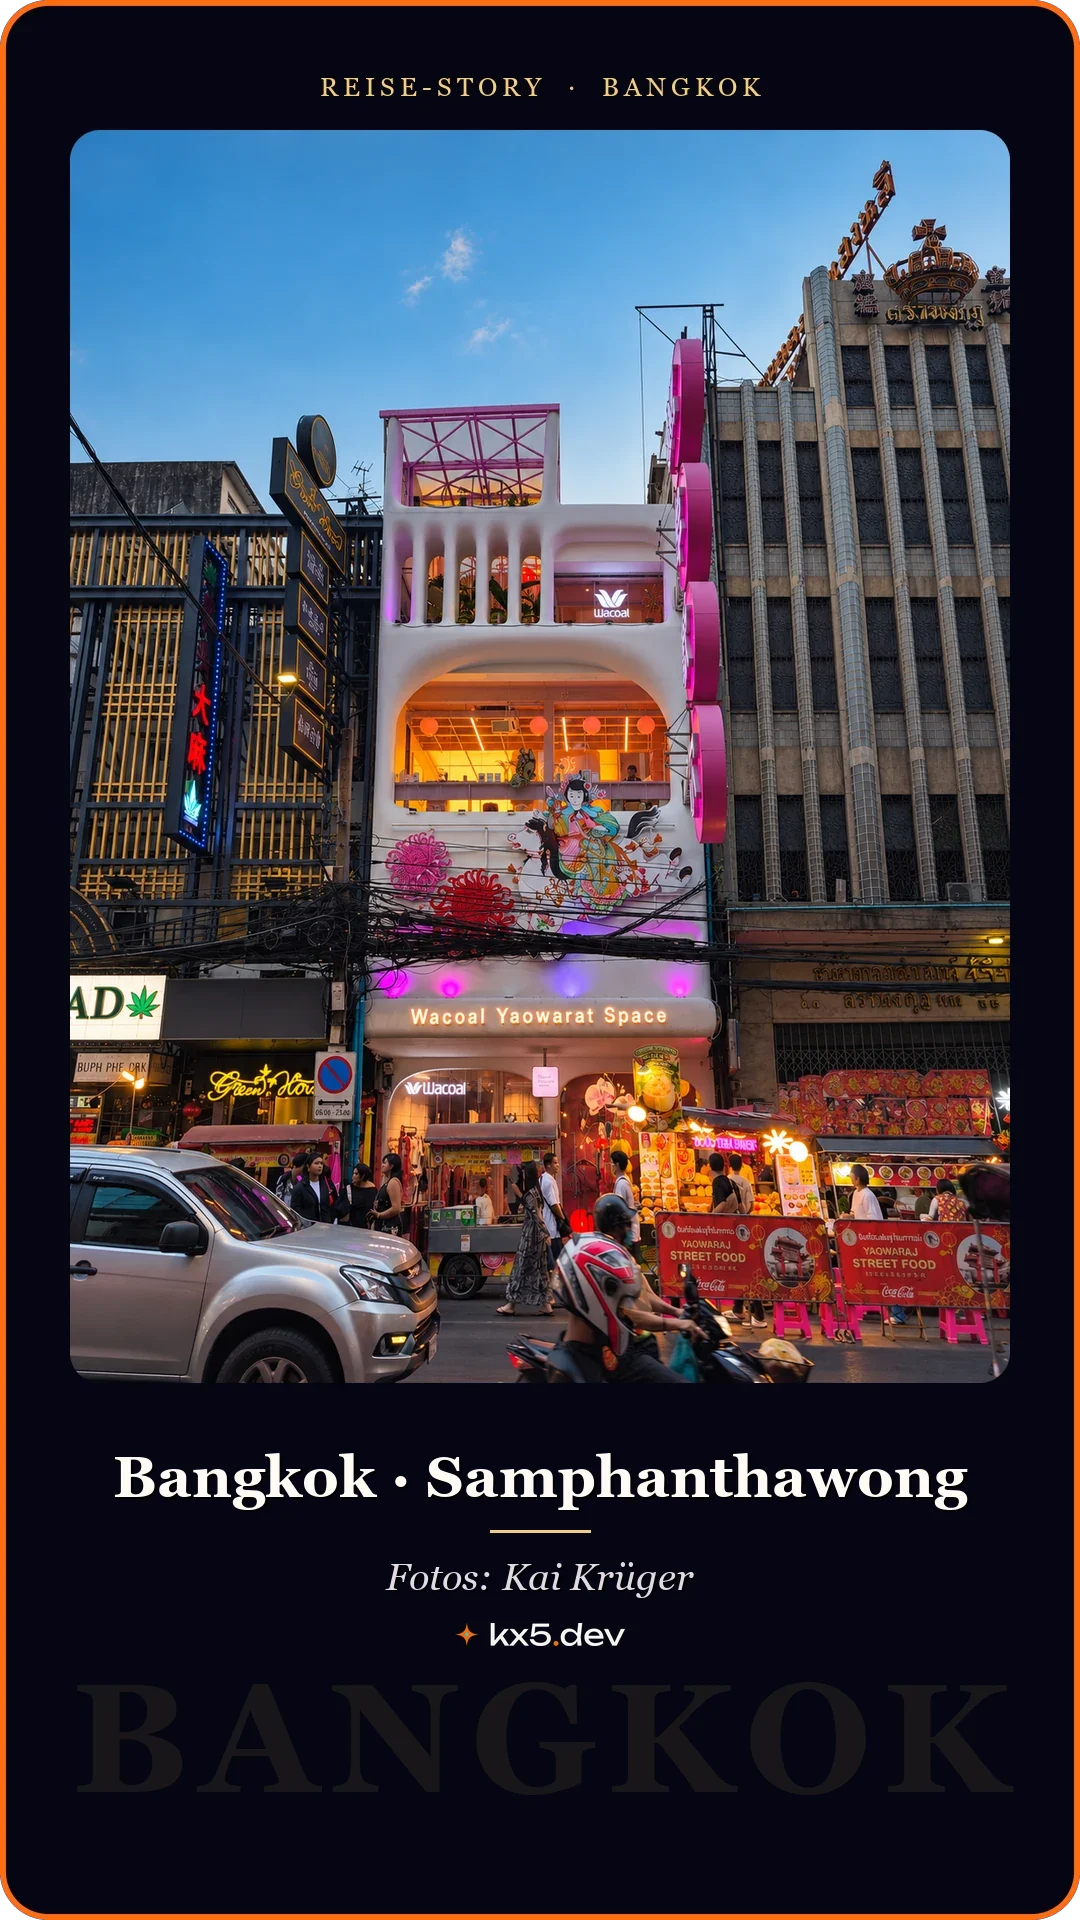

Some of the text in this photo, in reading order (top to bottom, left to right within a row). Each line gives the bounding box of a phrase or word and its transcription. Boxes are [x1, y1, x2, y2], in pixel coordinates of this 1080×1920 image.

[593, 608, 631, 619] Wacoal
[411, 1007, 668, 1027] Wacoal Yaowarat Space
[207, 1070, 266, 1102] Green
[422, 1082, 467, 1096] Wacoal
[681, 1240, 731, 1250] YAOWARAJ
[670, 1250, 746, 1263] STREET FOOD
[863, 1246, 919, 1257] YAOWARAJ
[852, 1258, 937, 1270] STREET FOOD
